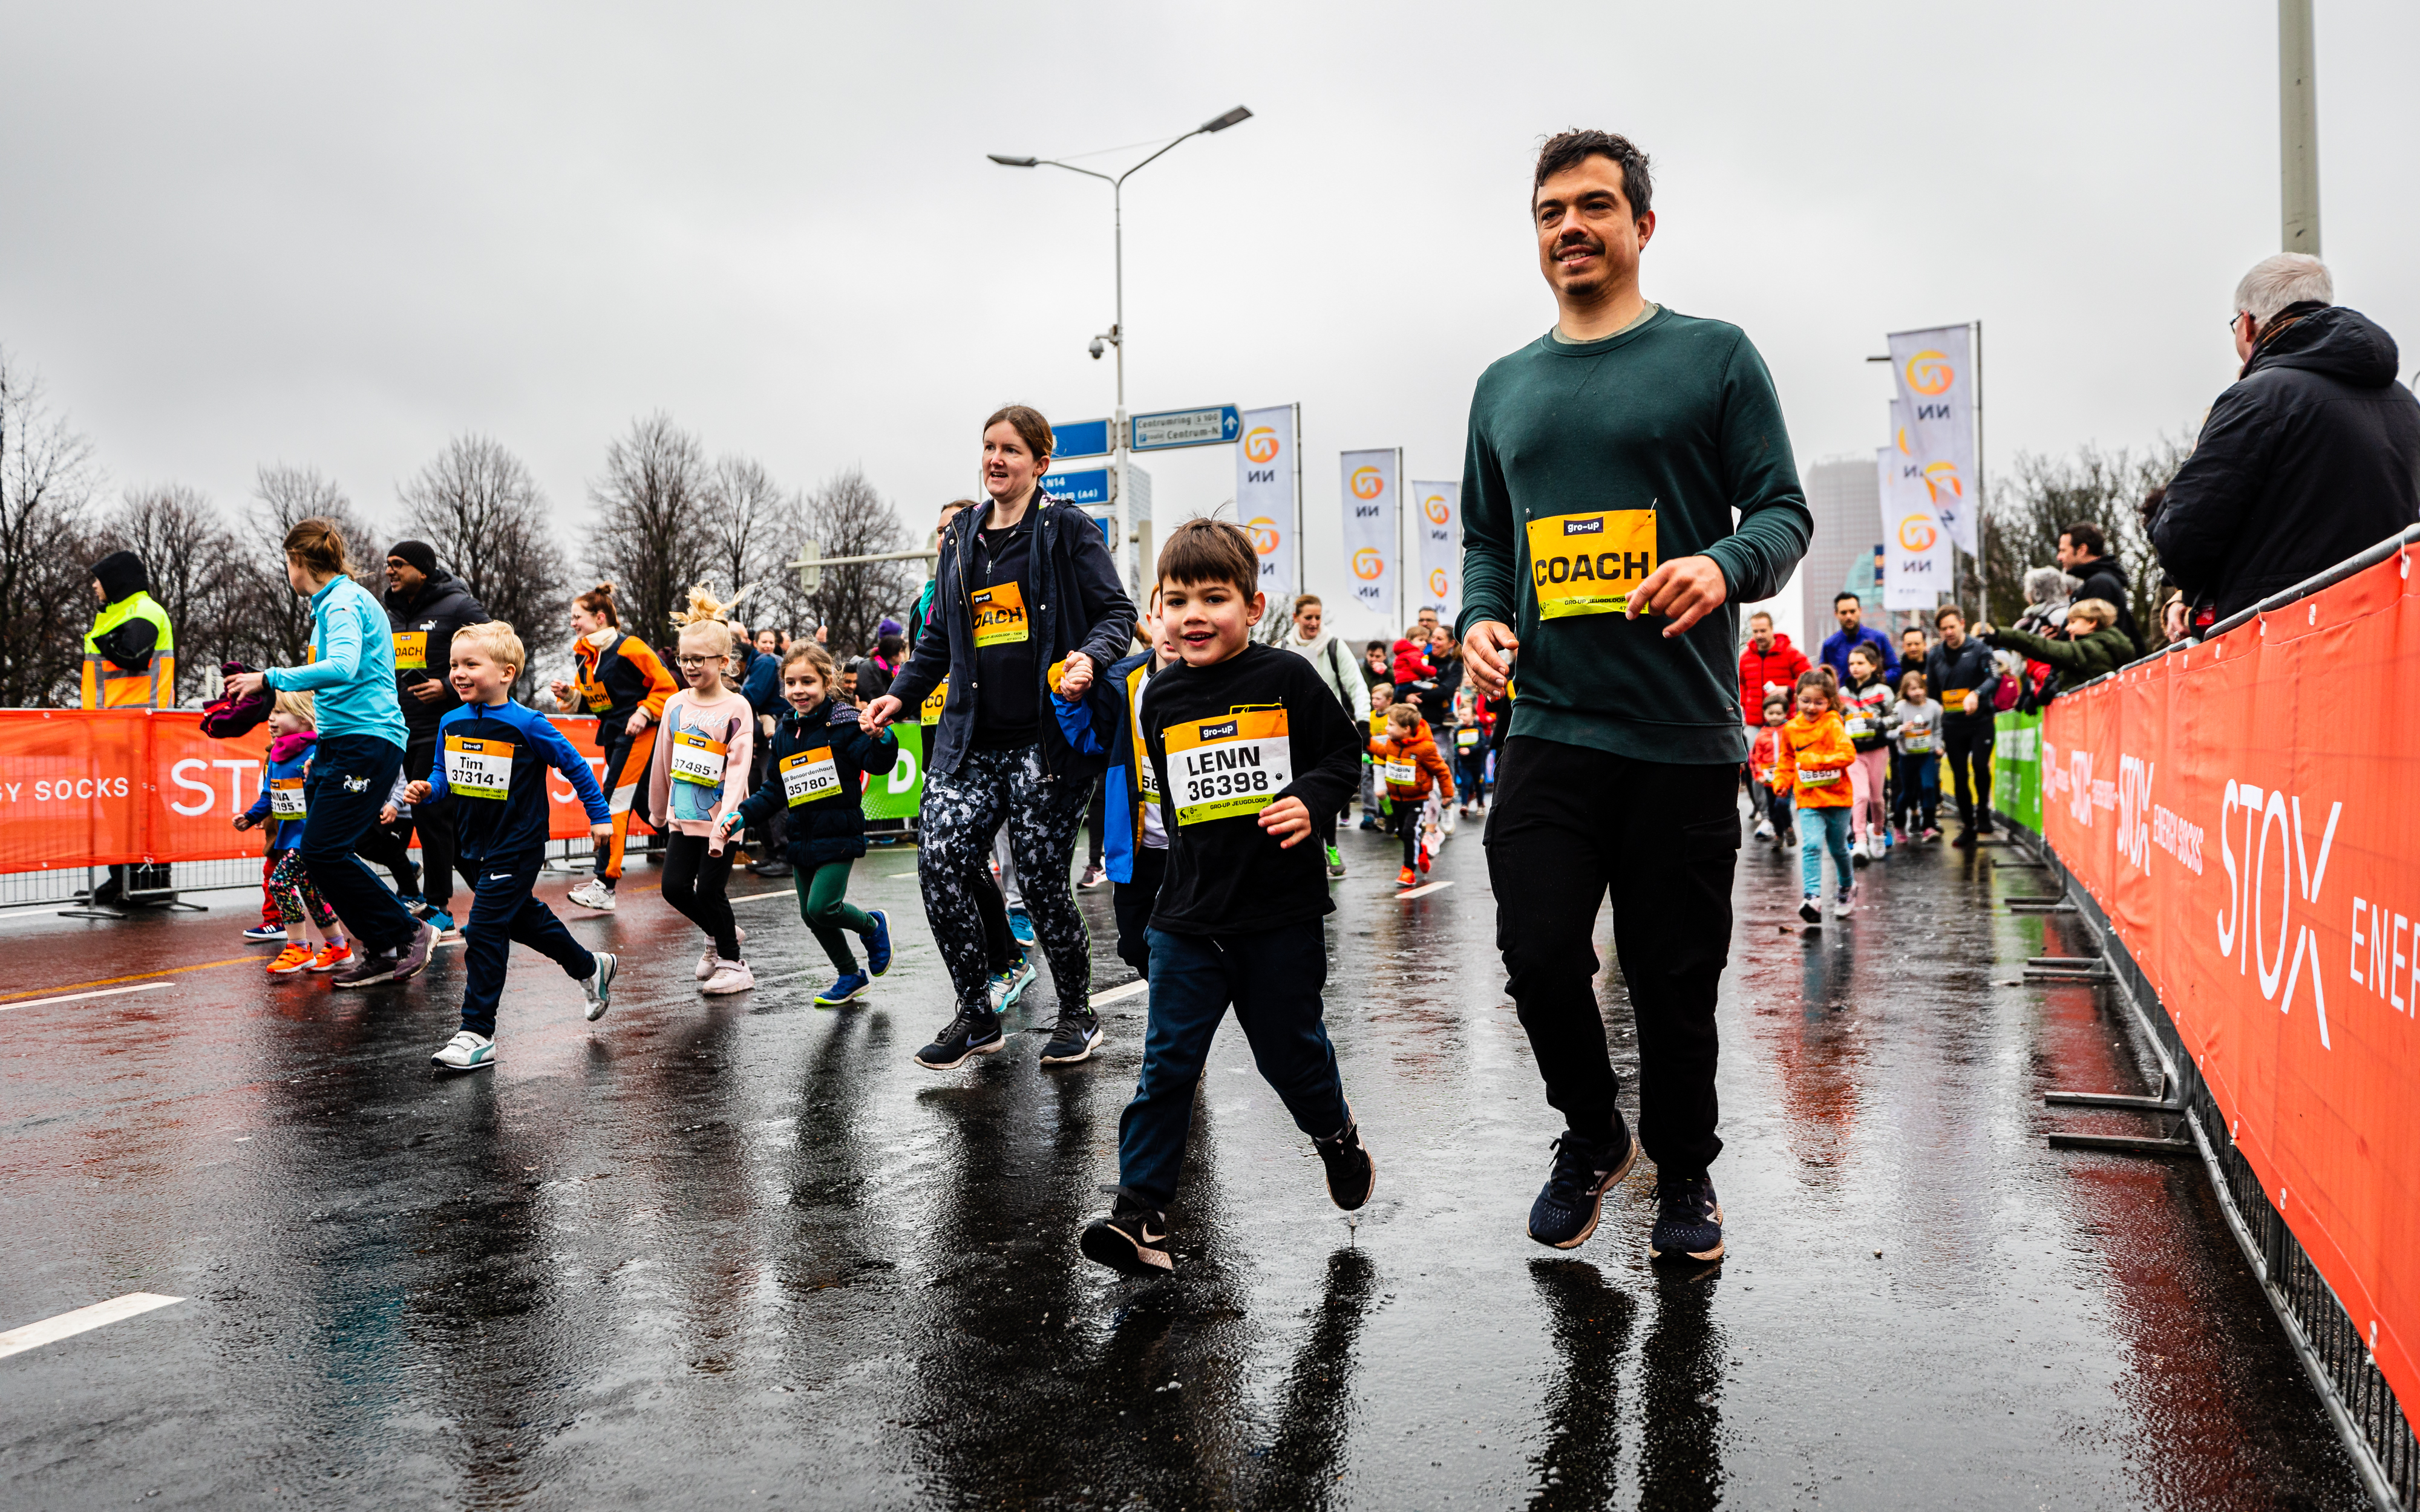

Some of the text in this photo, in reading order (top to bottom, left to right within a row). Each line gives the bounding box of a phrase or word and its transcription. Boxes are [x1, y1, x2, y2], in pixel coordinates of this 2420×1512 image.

[1137, 416, 1191, 428] Centrumring
[1568, 520, 1600, 533] gro-up
[1535, 552, 1649, 587] COACH
[975, 594, 990, 602] gro-up
[972, 607, 1023, 630] OACH
[395, 647, 423, 657] OACH
[925, 694, 944, 708] CO
[679, 709, 731, 732] Stitch
[1203, 725, 1234, 738] gro-up
[689, 738, 704, 747] gro-up
[460, 756, 483, 771] Tim
[674, 758, 711, 776] 37485
[1186, 746, 1261, 777] LENN
[452, 769, 494, 786] 37314
[790, 764, 834, 781] Benoordenhout
[34, 777, 129, 801] SOCKS
[171, 758, 264, 816] ST
[788, 777, 828, 796] 35780
[1187, 771, 1269, 801] 36398
[1210, 797, 1267, 810] GRO-UP JEUGDLOOP
[2117, 753, 2154, 877] STOX
[2178, 817, 2204, 876] SOCKS
[2217, 778, 2343, 1051] STOX
